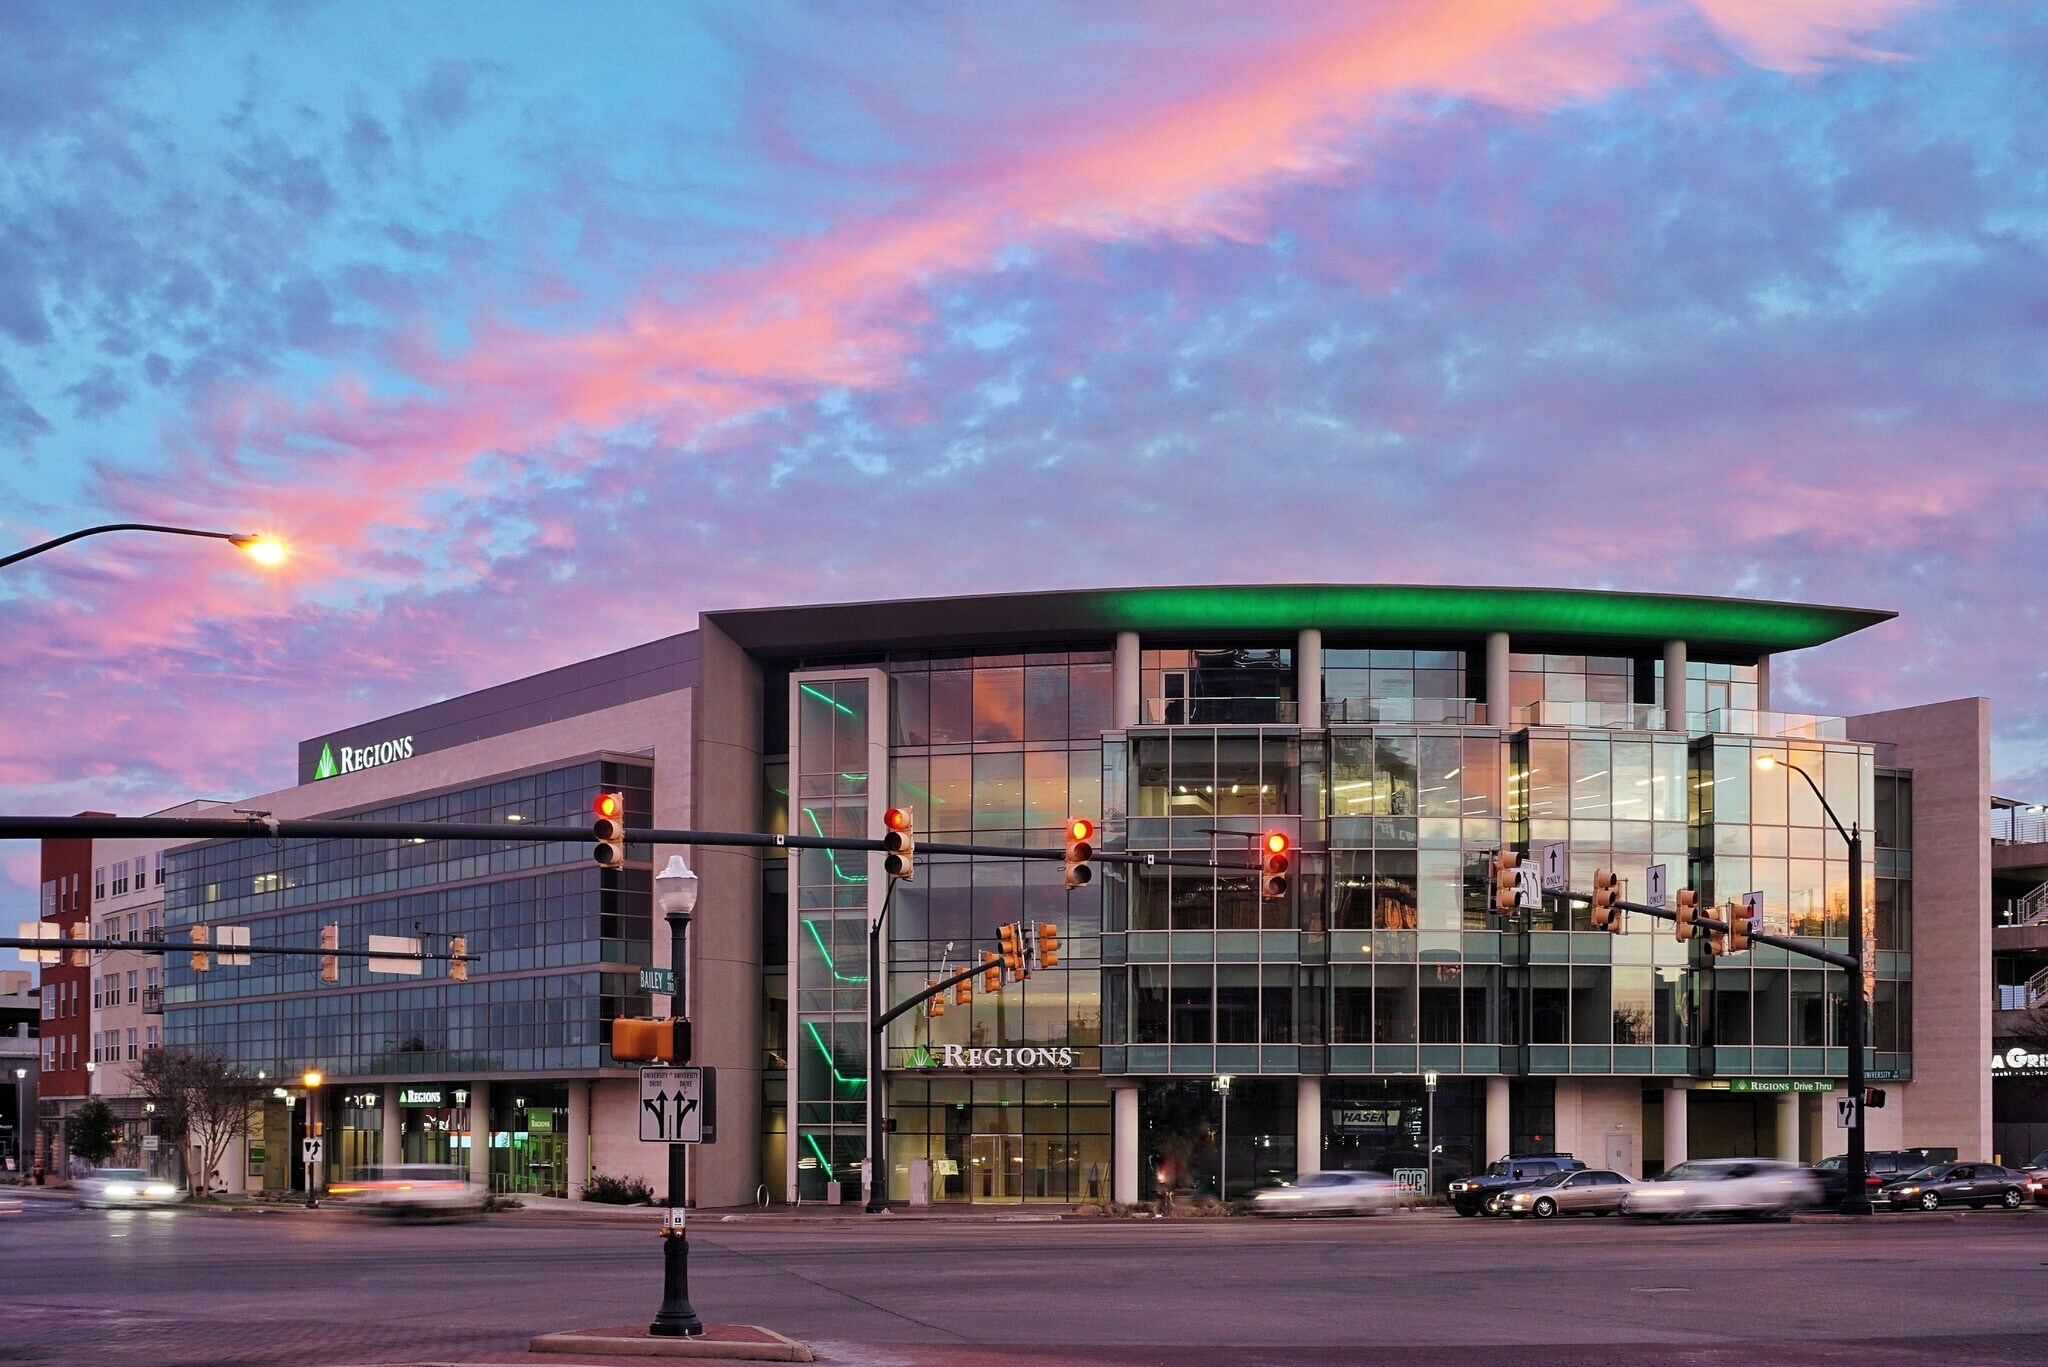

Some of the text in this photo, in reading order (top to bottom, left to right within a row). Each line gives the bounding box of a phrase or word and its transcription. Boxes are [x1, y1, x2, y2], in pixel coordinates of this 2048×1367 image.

[341, 736, 413, 774] REGIONS
[1547, 875, 1561, 886] ONLY
[1650, 895, 1662, 905] ONLY
[641, 971, 663, 989] BAILEY
[943, 1044, 1072, 1067] REGIONS
[1751, 1081, 1832, 1090] REGIONS Drive Thru
[408, 1090, 440, 1103] REGIONS
